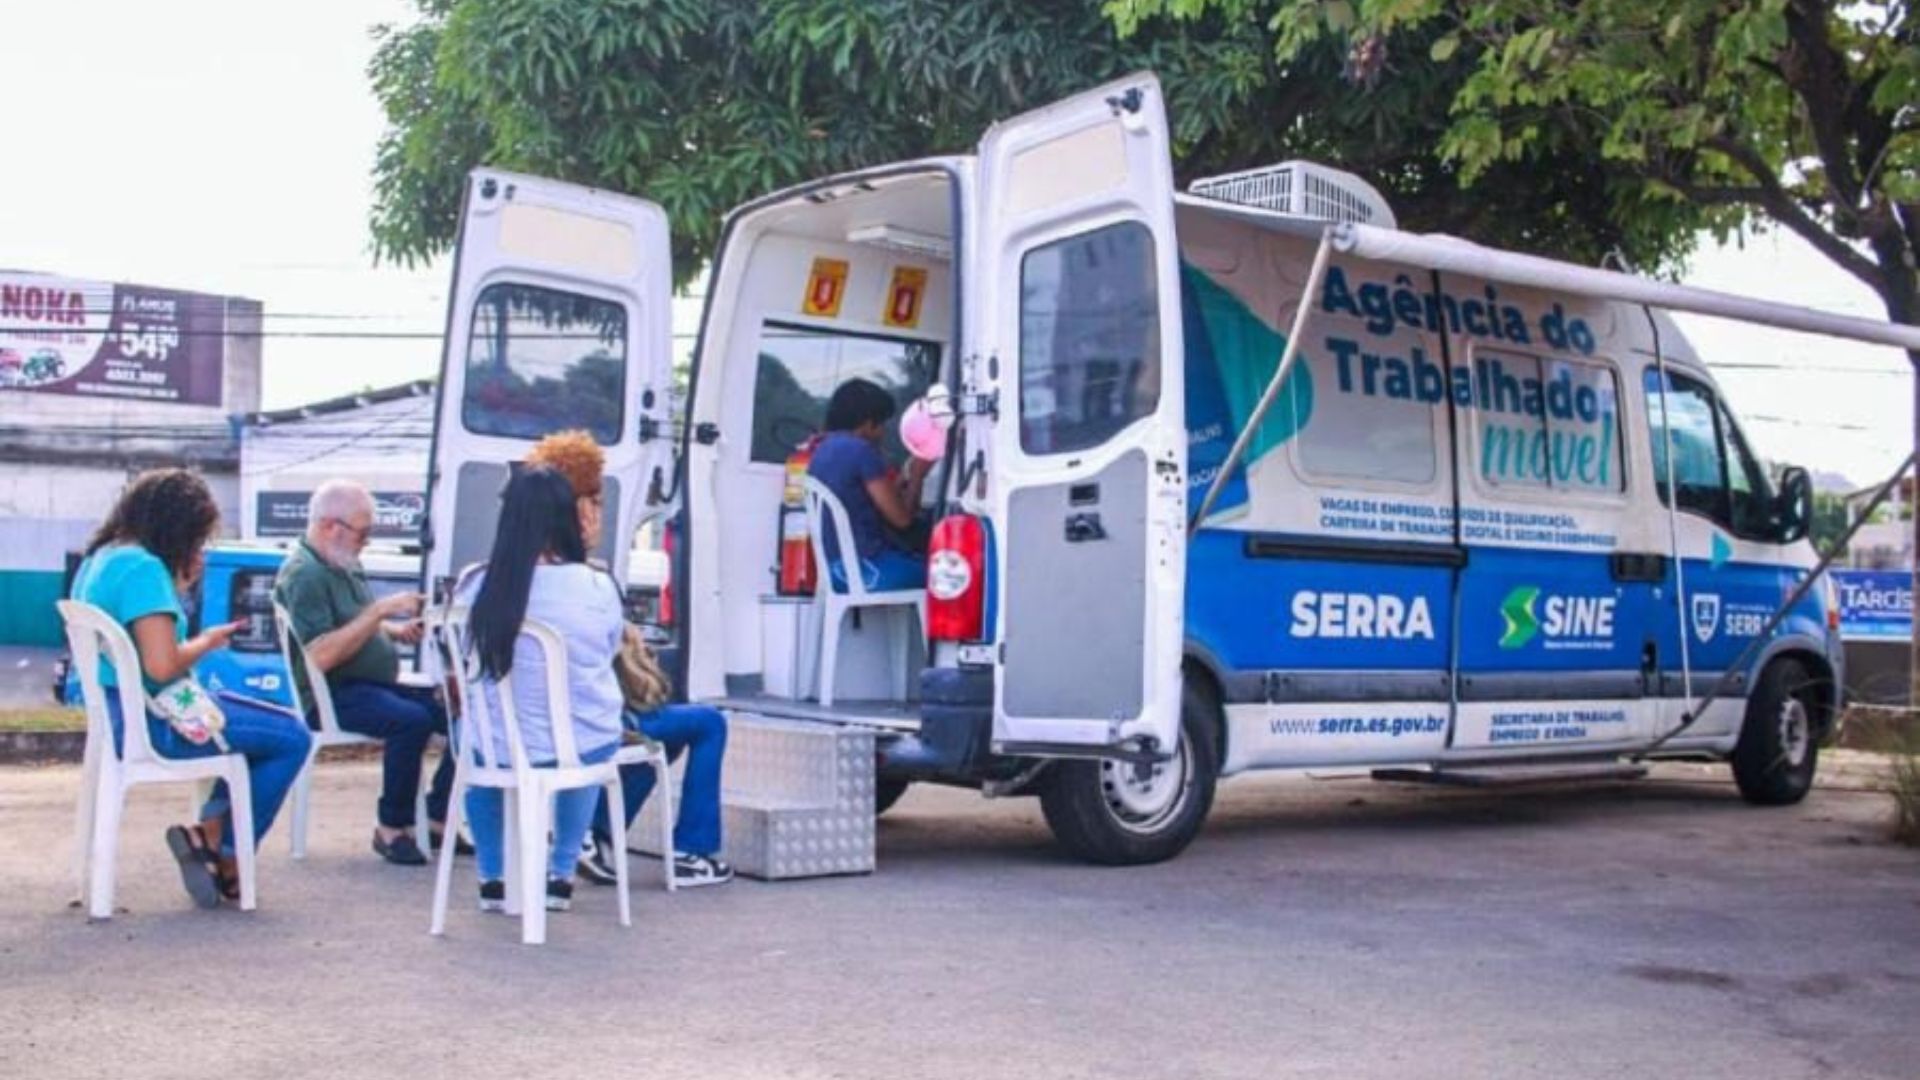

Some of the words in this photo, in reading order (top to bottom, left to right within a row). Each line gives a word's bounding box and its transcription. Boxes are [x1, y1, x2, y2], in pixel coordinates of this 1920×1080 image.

[2, 285, 86, 325] NOKA
[1322, 265, 1530, 345] Agência
[1540, 301, 1595, 356] do
[1320, 497, 1359, 513] VAGAS
[1362, 500, 1377, 514] DE
[1380, 519, 1395, 533] DE
[1290, 590, 1434, 639] SERRA
[1542, 596, 1616, 637] SINE
[1270, 712, 1445, 737] www.serra.es.gov.br
